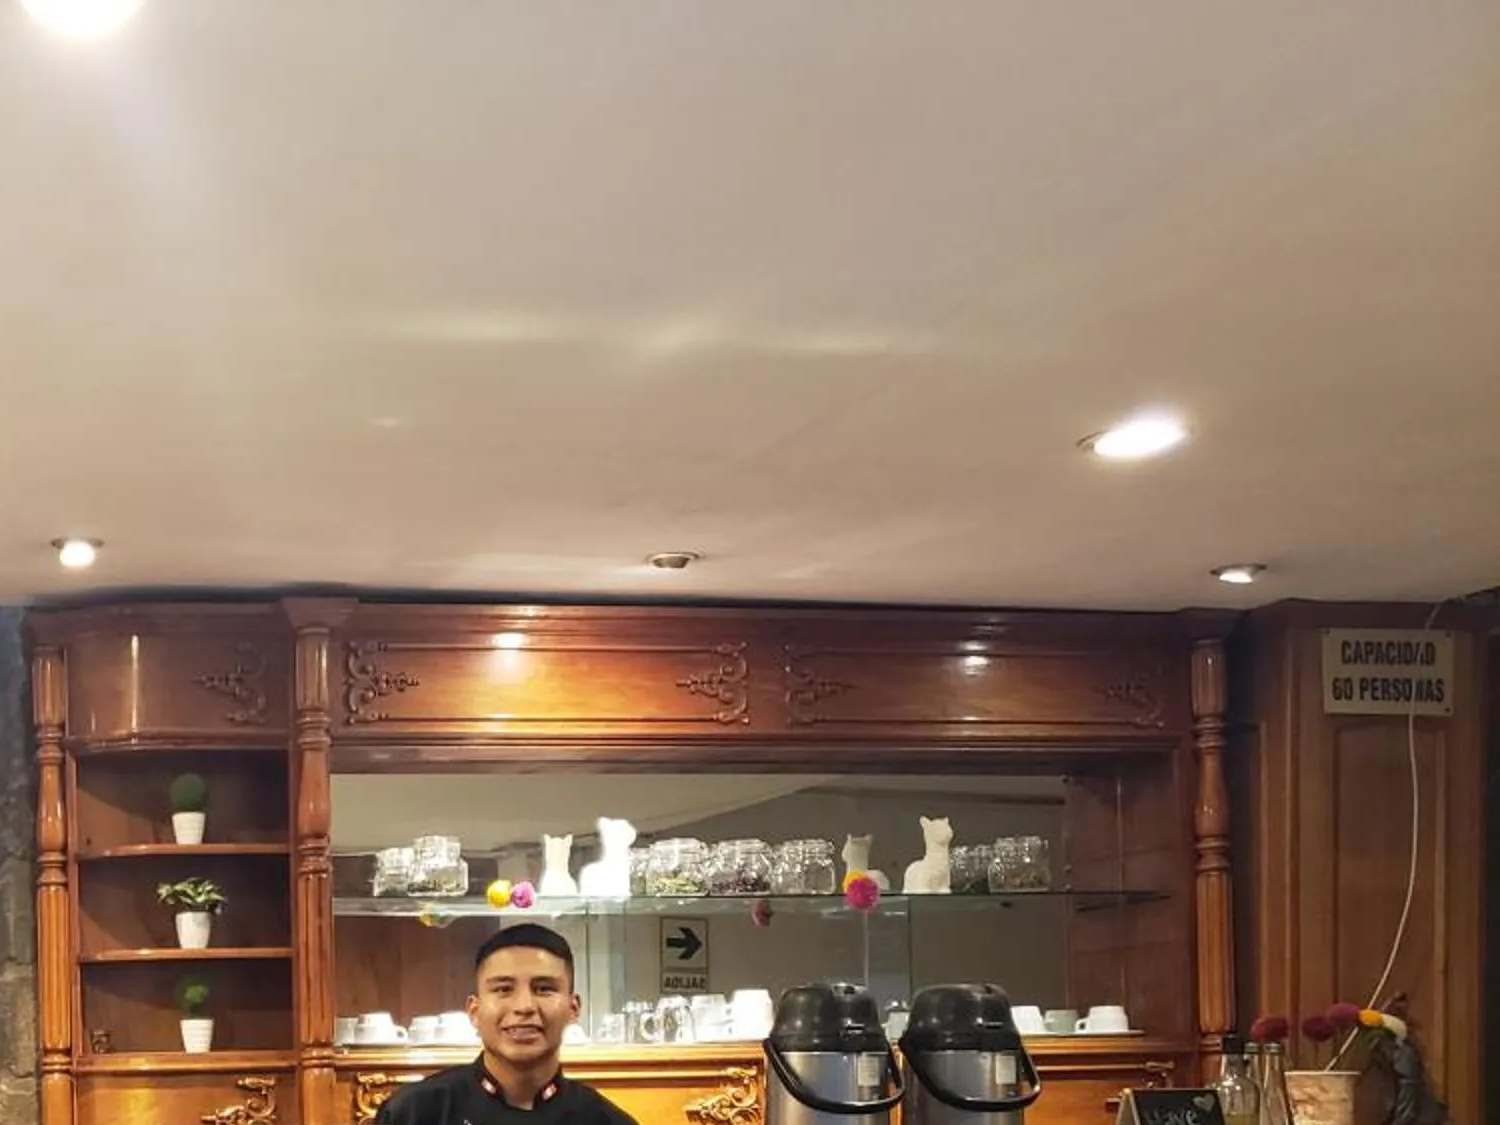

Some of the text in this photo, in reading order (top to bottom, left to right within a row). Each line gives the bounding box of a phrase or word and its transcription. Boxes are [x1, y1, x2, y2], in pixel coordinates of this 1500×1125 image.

[1341, 640, 1436, 666] CAPACIDAD
[1332, 677, 1445, 703] 60 PERSONAS
